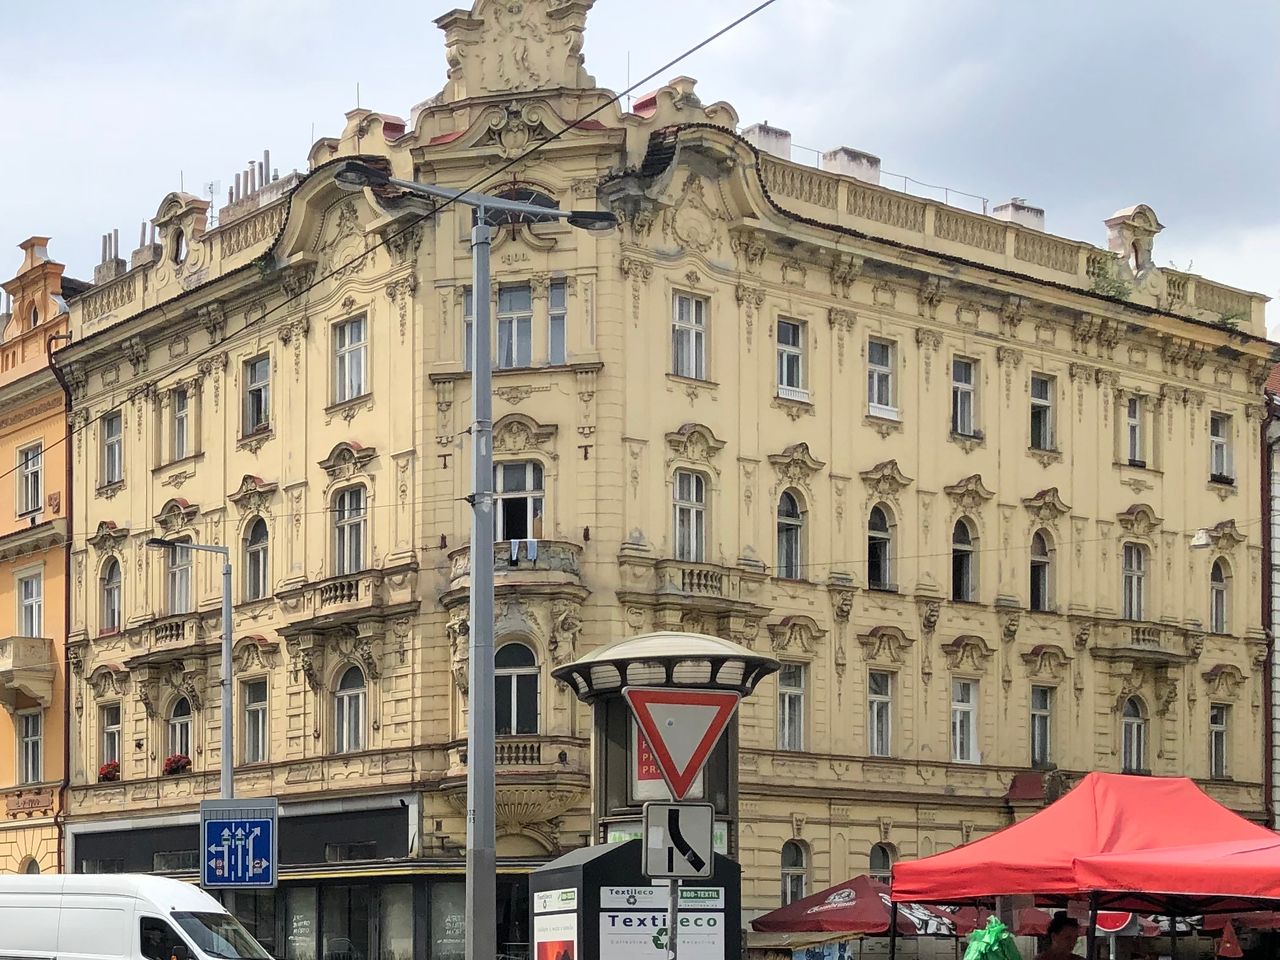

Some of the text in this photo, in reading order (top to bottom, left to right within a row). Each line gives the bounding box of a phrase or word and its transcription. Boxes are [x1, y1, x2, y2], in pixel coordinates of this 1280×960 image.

[608, 888, 654, 896] Textileco
[682, 890, 719, 898] 800-TEXTIL
[607, 914, 718, 928] Textieco
